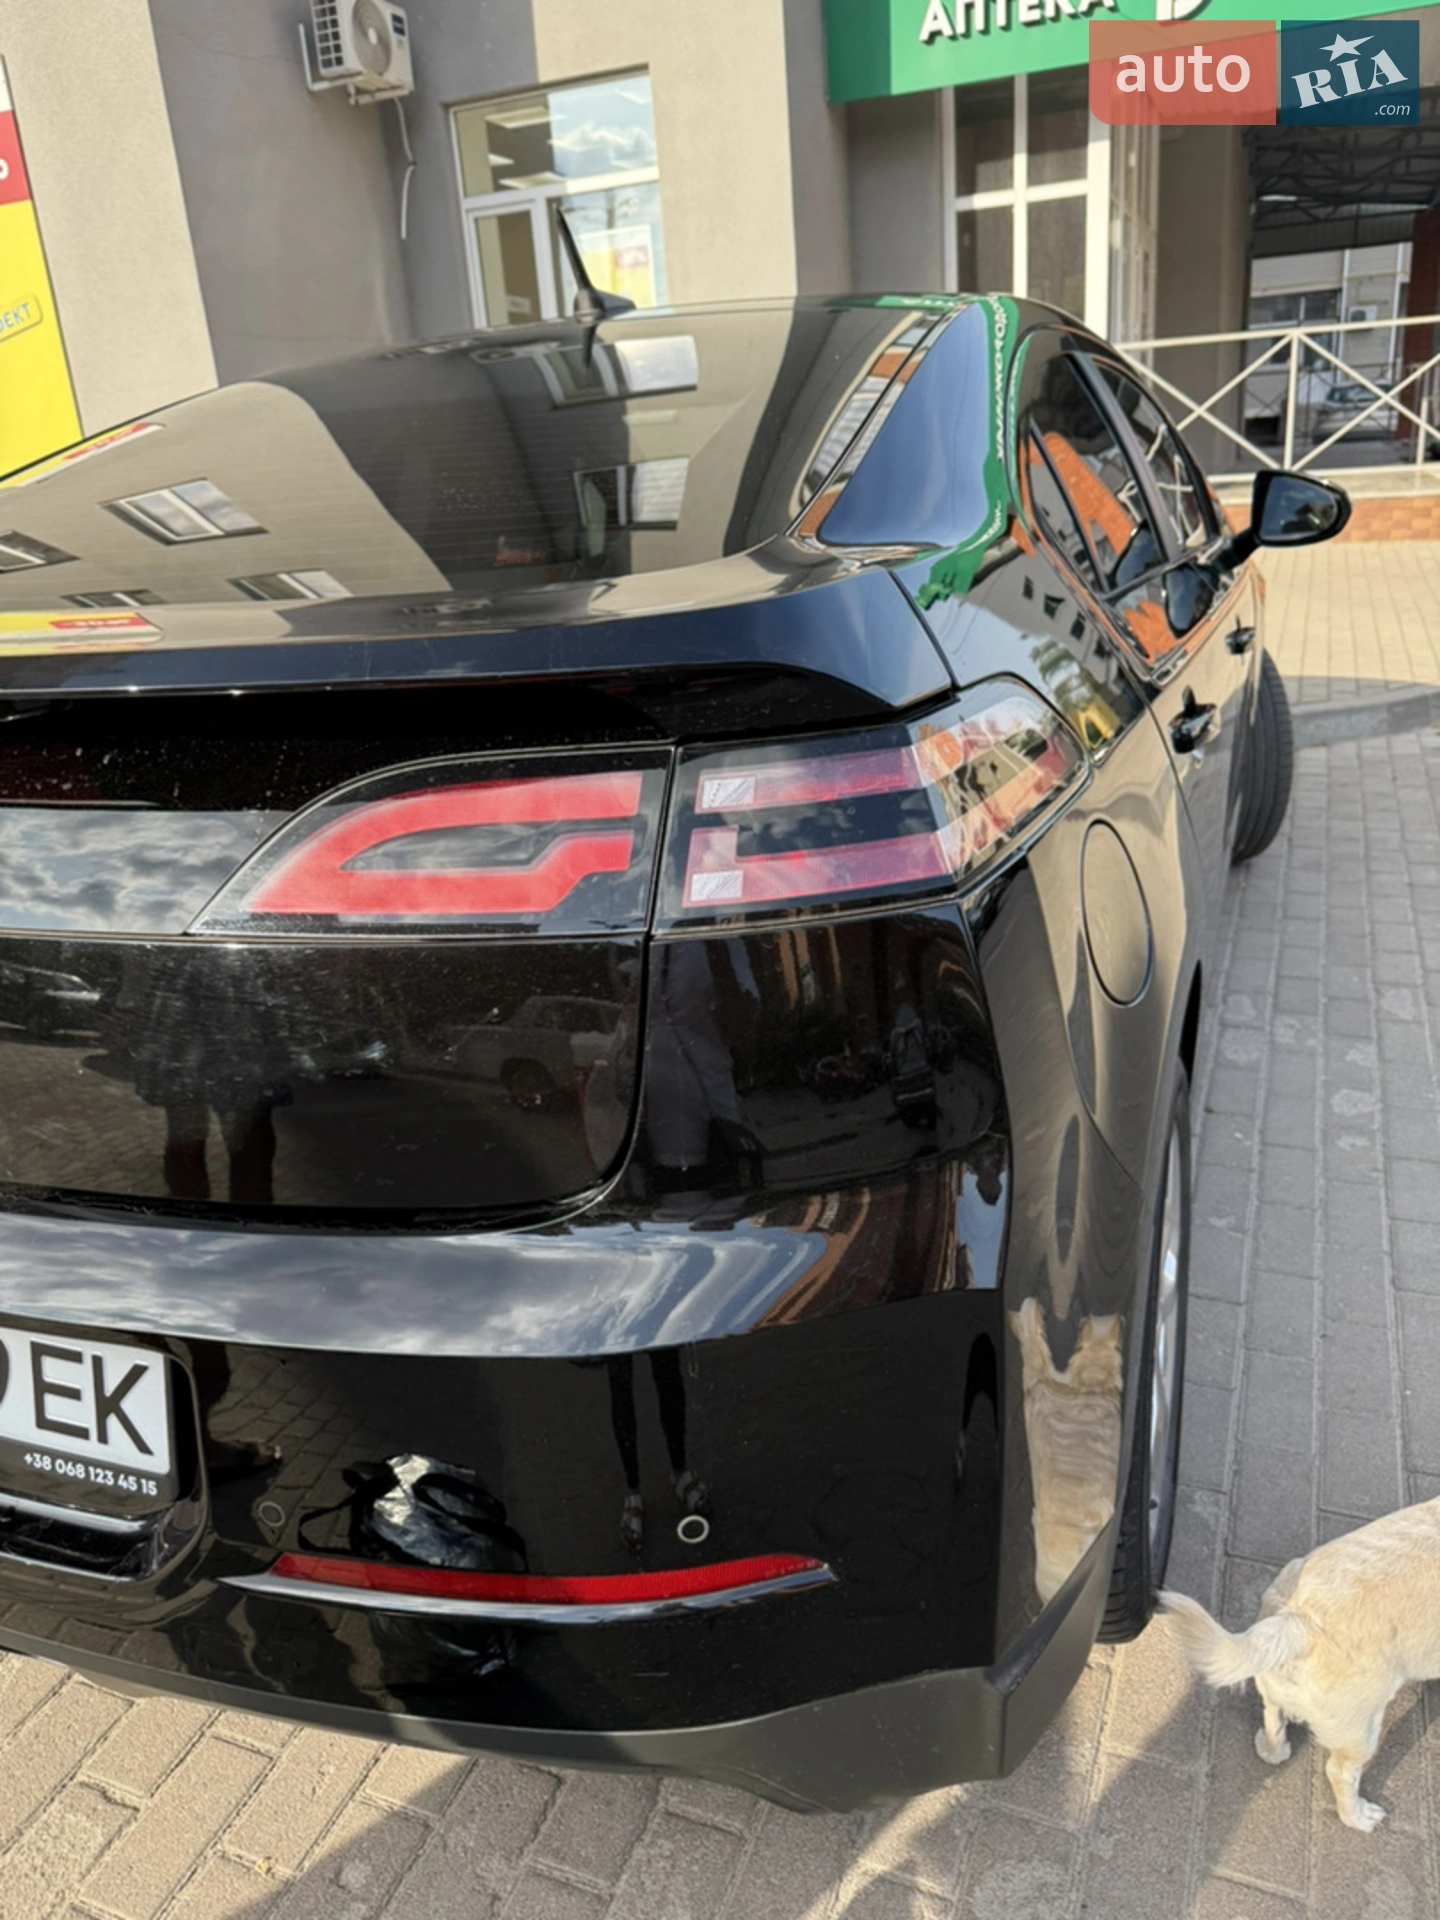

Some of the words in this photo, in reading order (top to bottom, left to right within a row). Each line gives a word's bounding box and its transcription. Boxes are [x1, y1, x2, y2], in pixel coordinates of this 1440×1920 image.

[919, 0, 1117, 43] АПТЕ
[24, 1453, 51, 1471] +38
[54, 1459, 86, 1479] 068
[88, 1466, 115, 1486] 123
[117, 1474, 138, 1491] 45
[140, 1478, 158, 1496] 15
